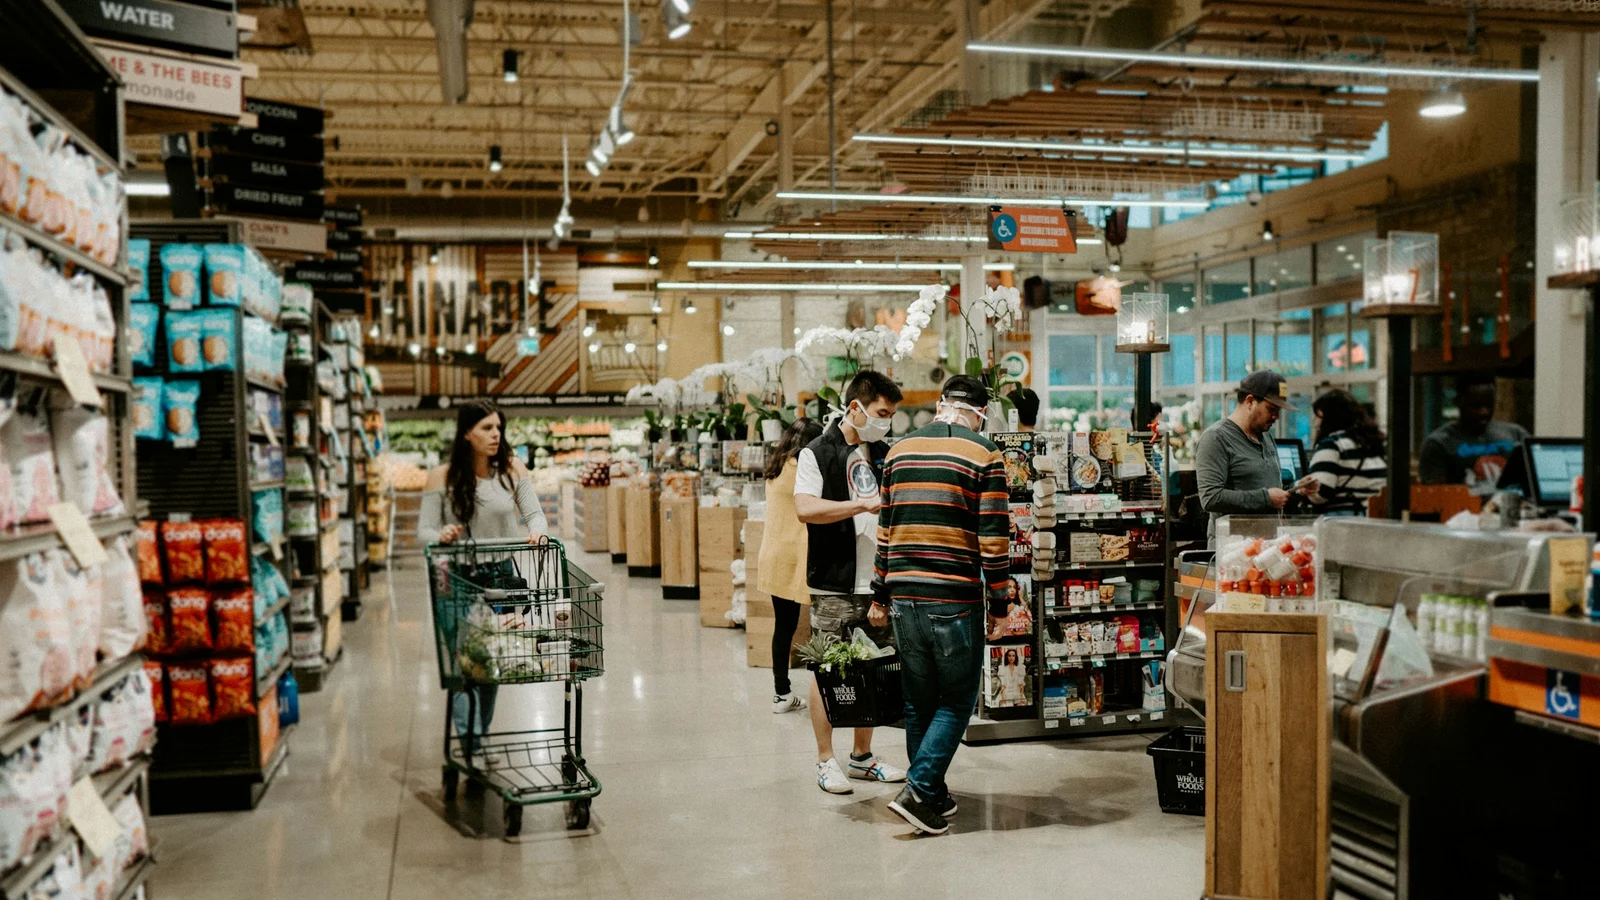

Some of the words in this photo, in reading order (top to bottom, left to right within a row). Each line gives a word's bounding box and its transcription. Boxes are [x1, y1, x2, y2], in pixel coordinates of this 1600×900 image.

[100, 2, 174, 31] WATER
[134, 60, 145, 75] &
[151, 63, 185, 82] THE
[191, 69, 232, 90] BEES
[245, 102, 297, 120] OPCORN
[252, 133, 286, 148] CHIPS
[252, 162, 287, 177] SALSA
[234, 188, 270, 203] DRIED
[272, 191, 304, 207] FRUIT
[833, 686, 856, 694] WHOLE
[1176, 774, 1204, 783] WHOLE
[1177, 781, 1204, 791] FOODS
